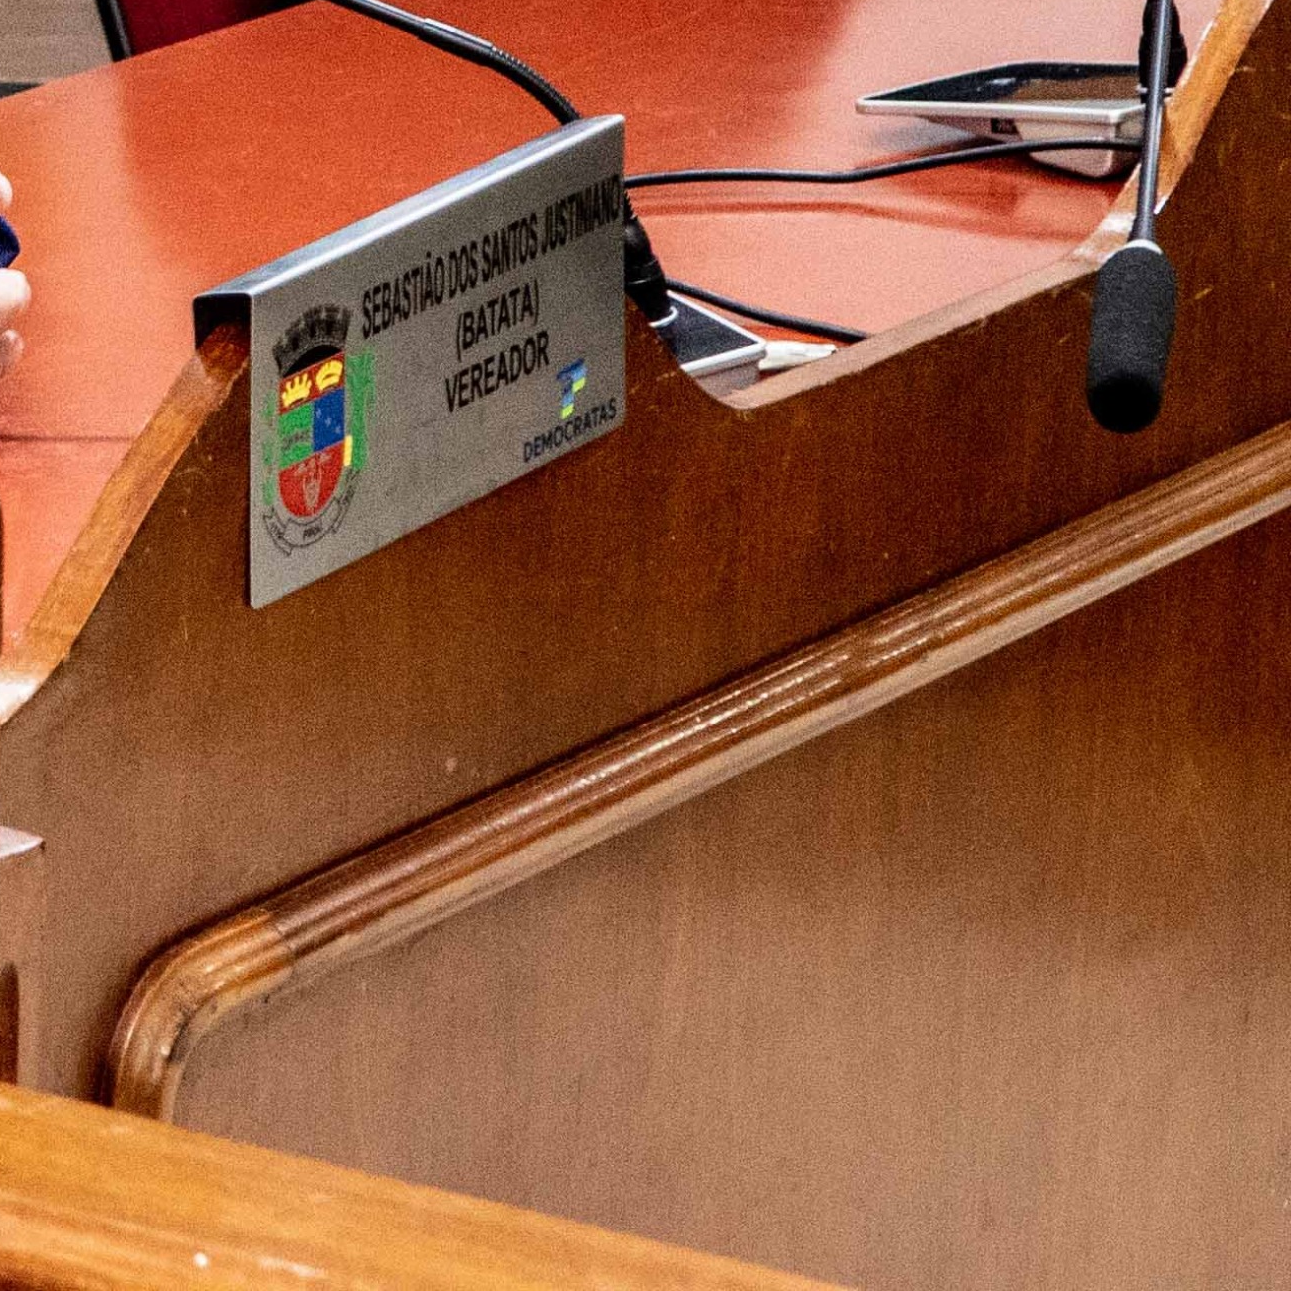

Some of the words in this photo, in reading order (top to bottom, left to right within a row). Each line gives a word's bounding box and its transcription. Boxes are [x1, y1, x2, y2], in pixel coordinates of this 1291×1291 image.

[362, 251, 444, 339] SEBASTIÃO
[448, 240, 478, 298] DOS
[482, 212, 537, 282] SANTOS
[456, 279, 539, 361] (BATATA)
[445, 330, 550, 412] VEREADOR
[523, 397, 617, 462] DEMOCRATAS
